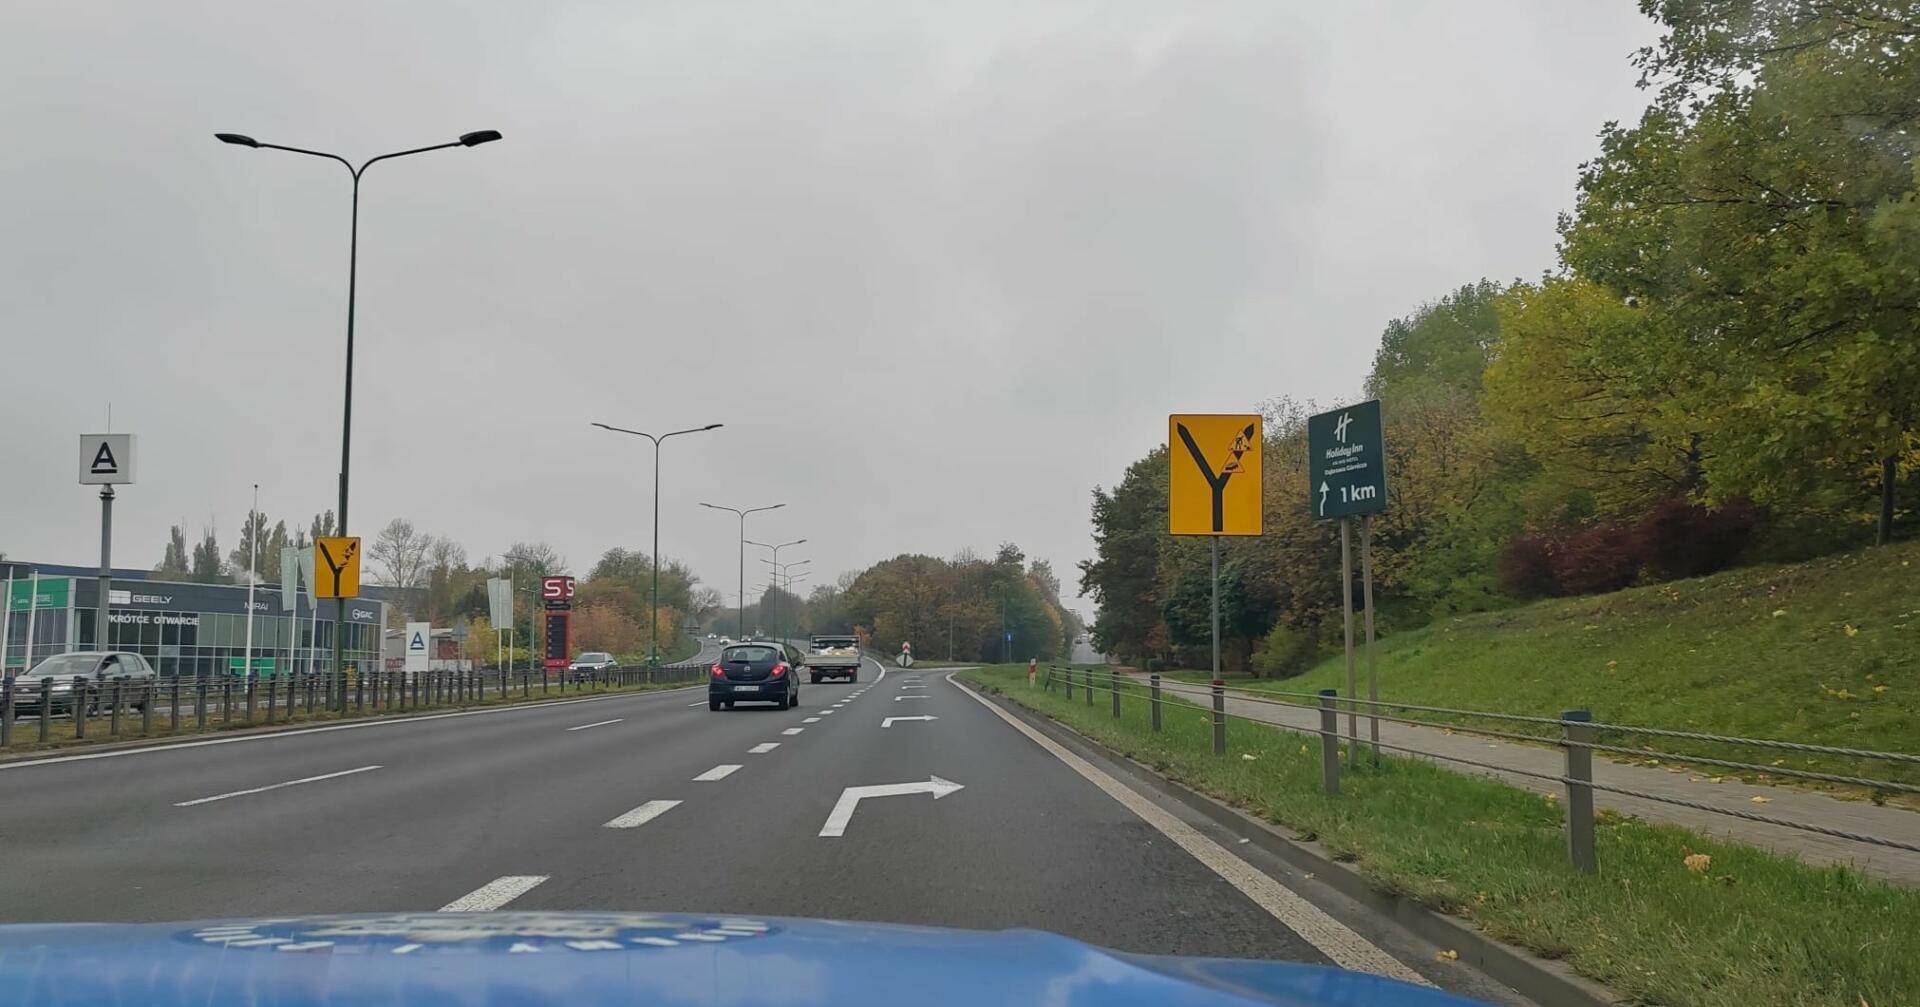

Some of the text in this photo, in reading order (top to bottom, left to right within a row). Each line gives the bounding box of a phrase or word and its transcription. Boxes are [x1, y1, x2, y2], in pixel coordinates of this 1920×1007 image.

[1325, 443, 1363, 459] Holiday Inn
[1340, 484, 1376, 503] 1 km
[132, 594, 173, 604] GEELY
[108, 613, 200, 626] KRÓTCE OTWARCIE
